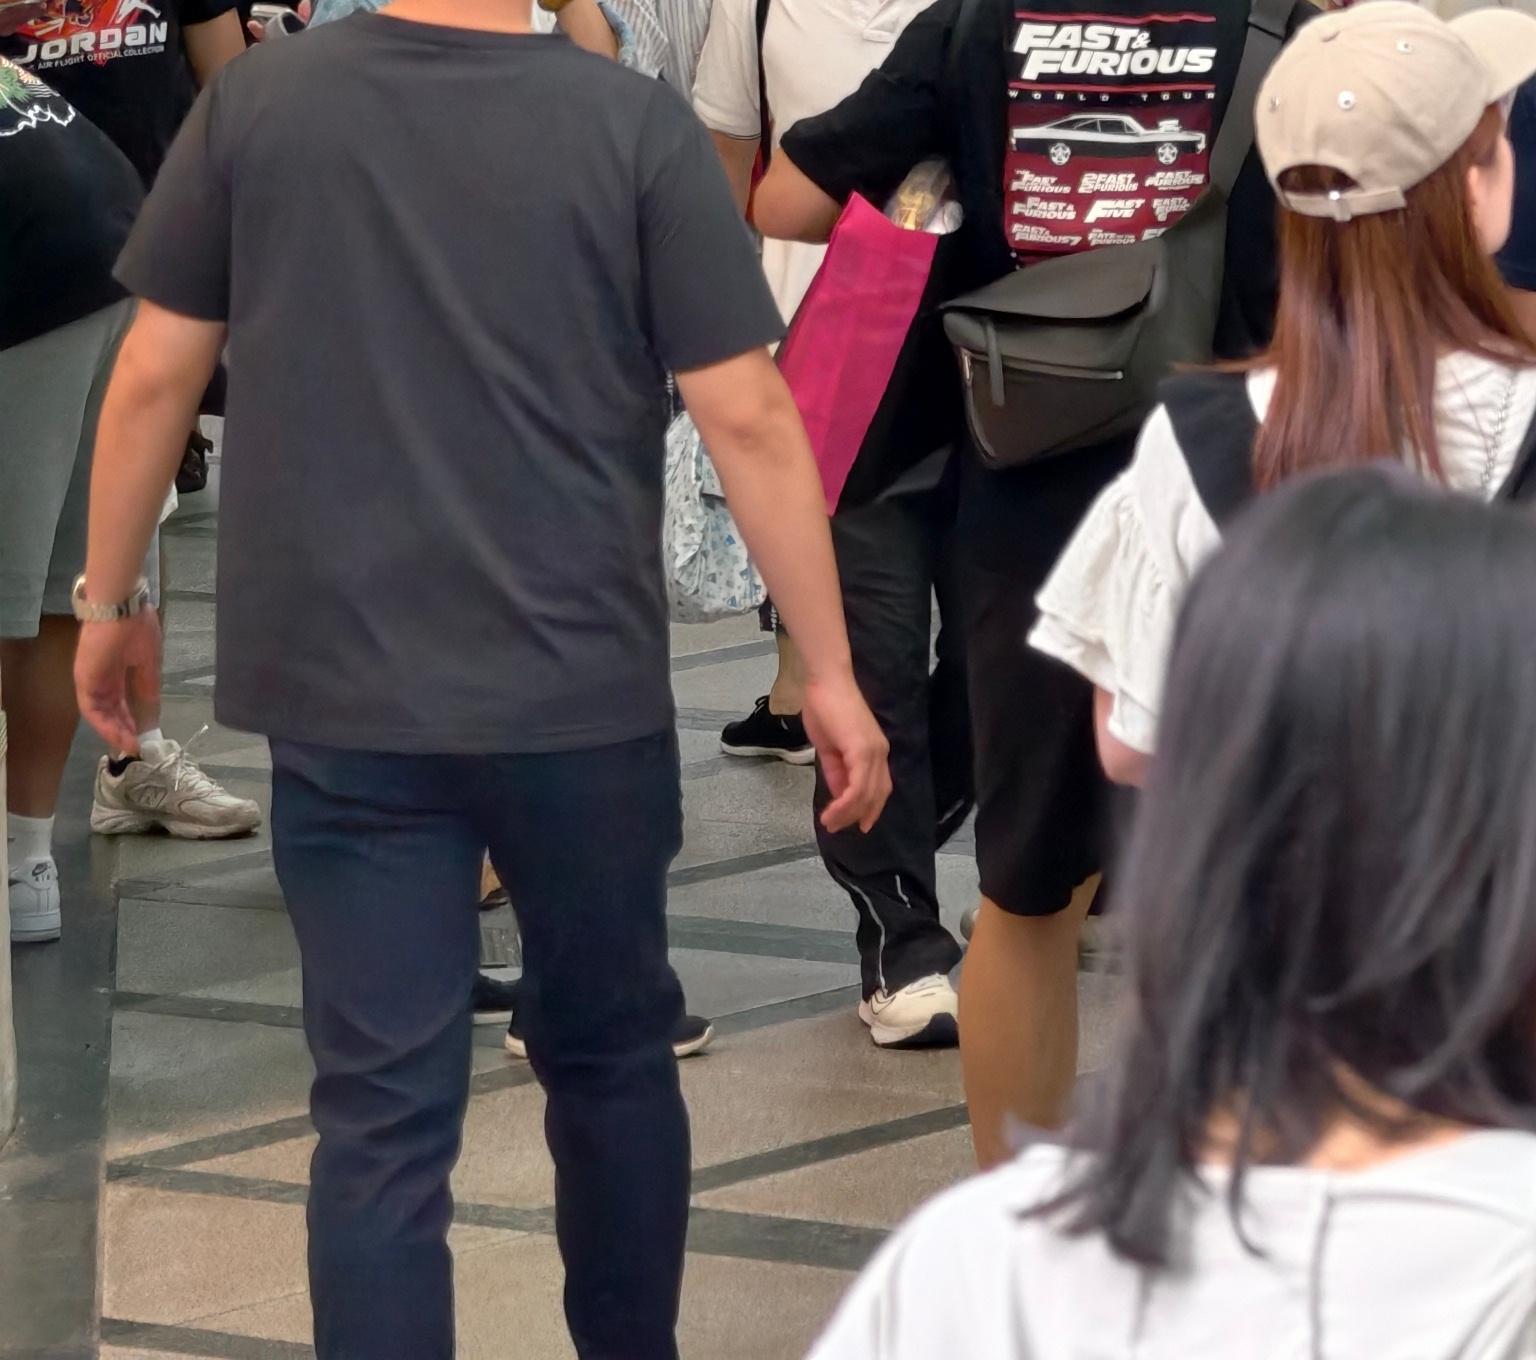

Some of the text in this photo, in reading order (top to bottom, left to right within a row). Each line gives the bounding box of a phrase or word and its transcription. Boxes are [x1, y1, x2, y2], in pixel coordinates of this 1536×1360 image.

[1021, 47, 1217, 80] FURIOUS
[1008, 90, 1216, 102] WORLD TOUR
